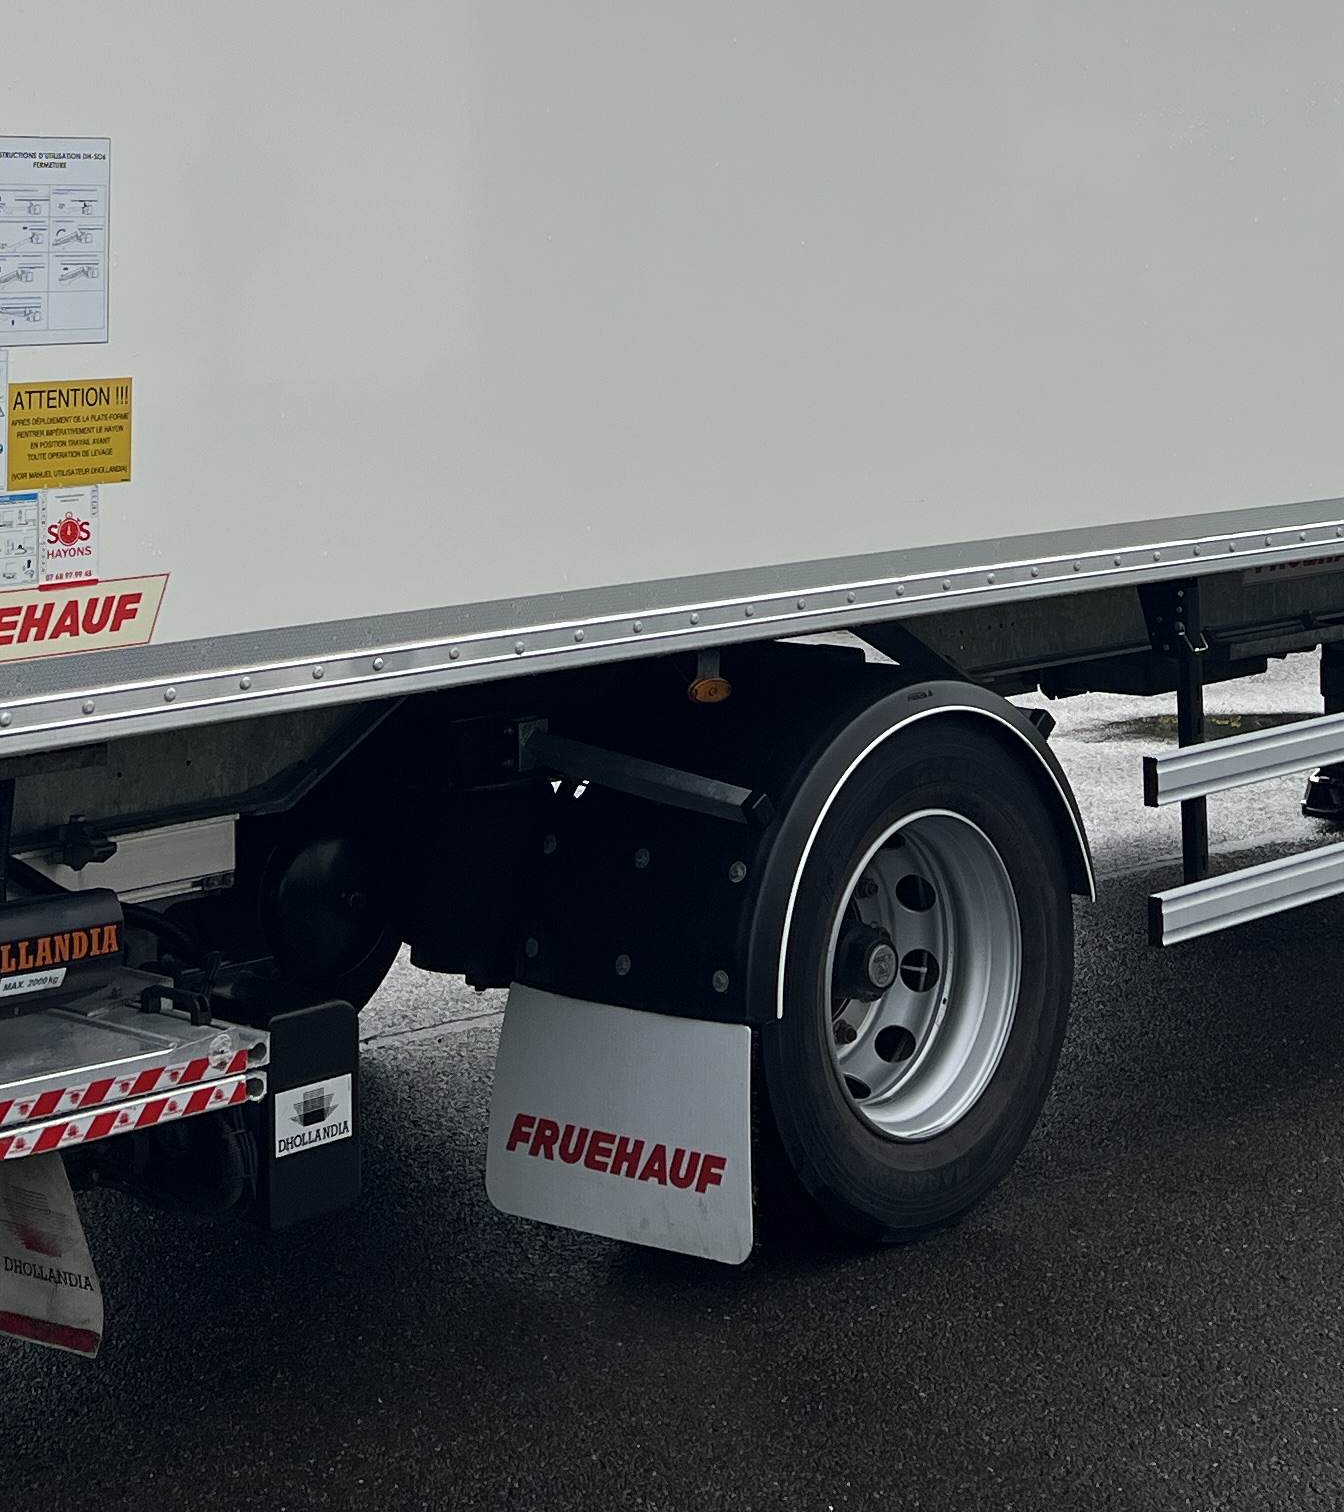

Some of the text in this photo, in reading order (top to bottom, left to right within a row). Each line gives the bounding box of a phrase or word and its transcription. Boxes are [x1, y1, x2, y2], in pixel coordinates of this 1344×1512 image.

[12, 386, 111, 411] ATTENTION
[47, 545, 92, 560] HAYONS
[3, 979, 26, 992] MAX.
[278, 1120, 350, 1153] DHOLLANDIA
[506, 1113, 727, 1194] FRUEHAUF
[4, 1256, 95, 1292] DHOLLANDIA
